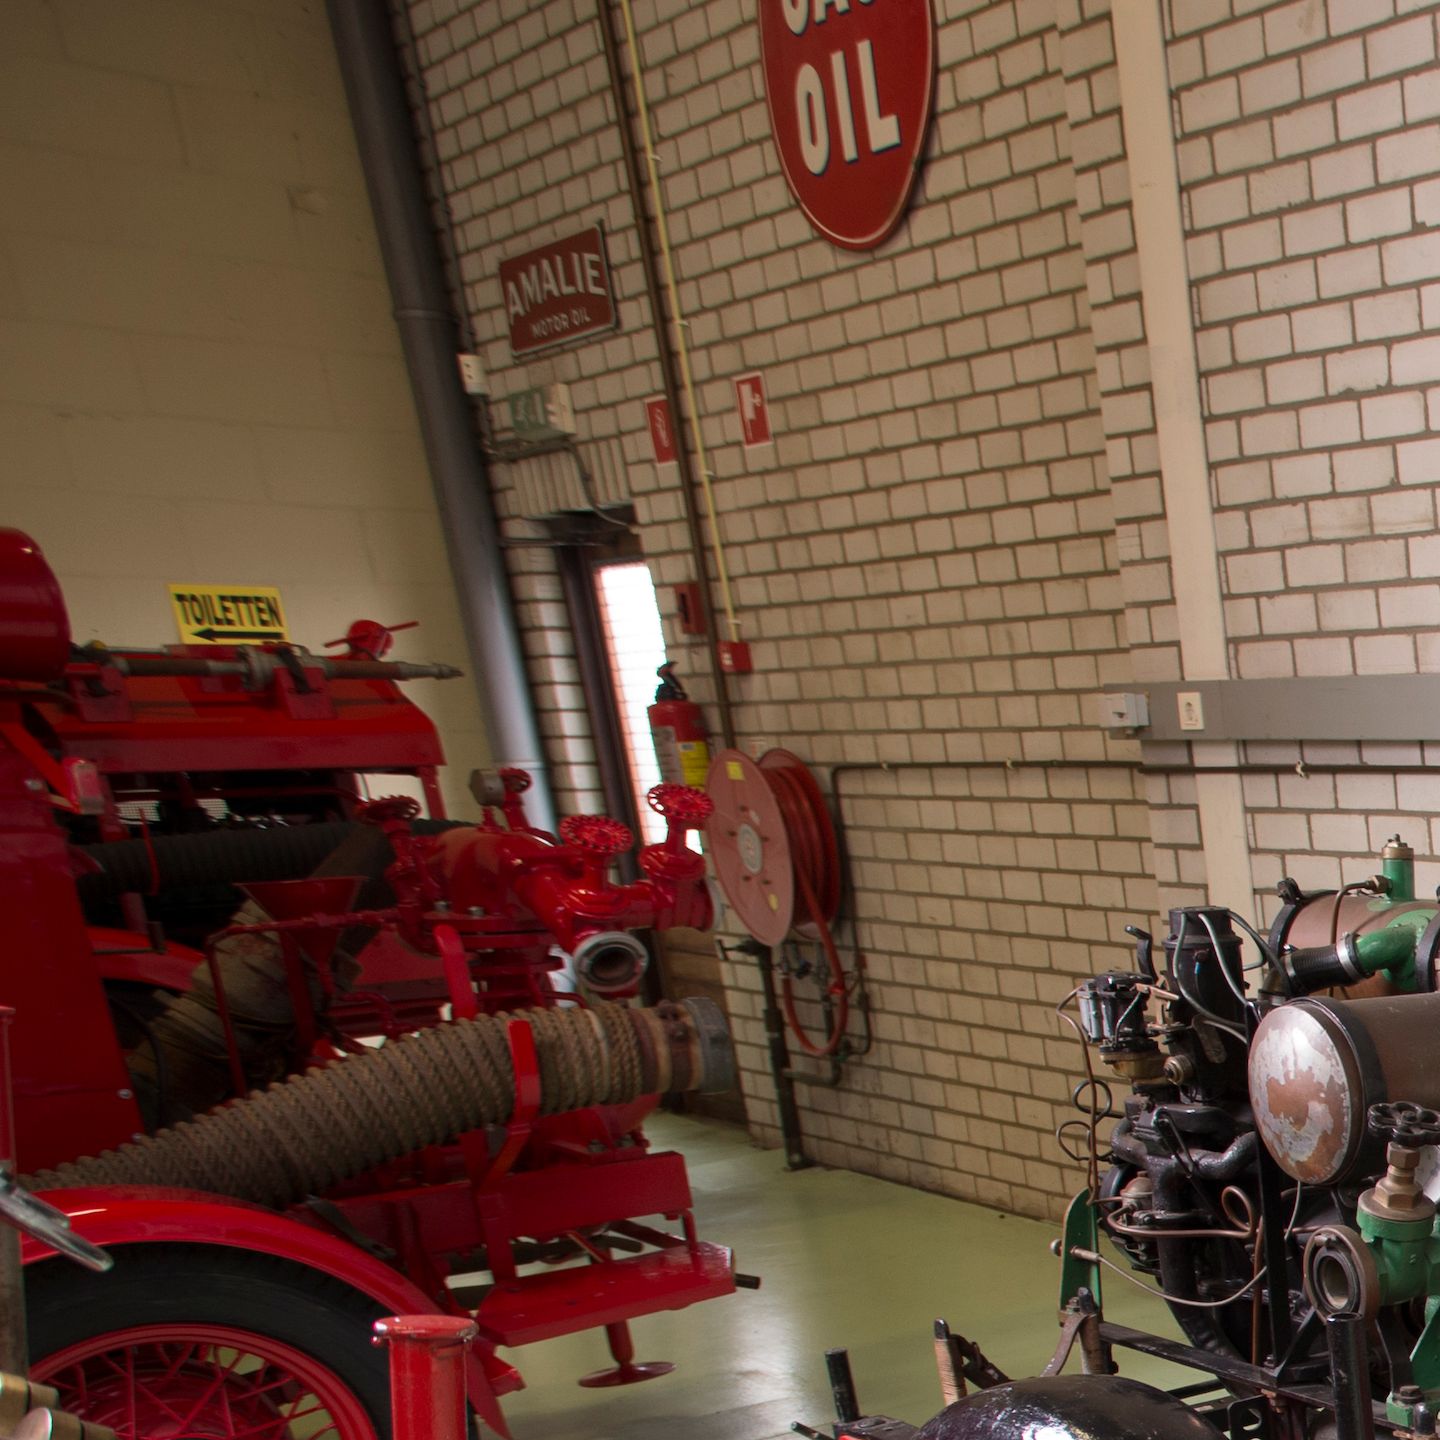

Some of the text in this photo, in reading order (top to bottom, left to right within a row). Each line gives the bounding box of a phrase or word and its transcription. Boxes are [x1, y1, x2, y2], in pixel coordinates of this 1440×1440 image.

[797, 40, 900, 176] OIL
[506, 252, 607, 326] AMALIE
[530, 307, 592, 338] MOTOR OIL
[174, 593, 285, 627] TOILETTEN
